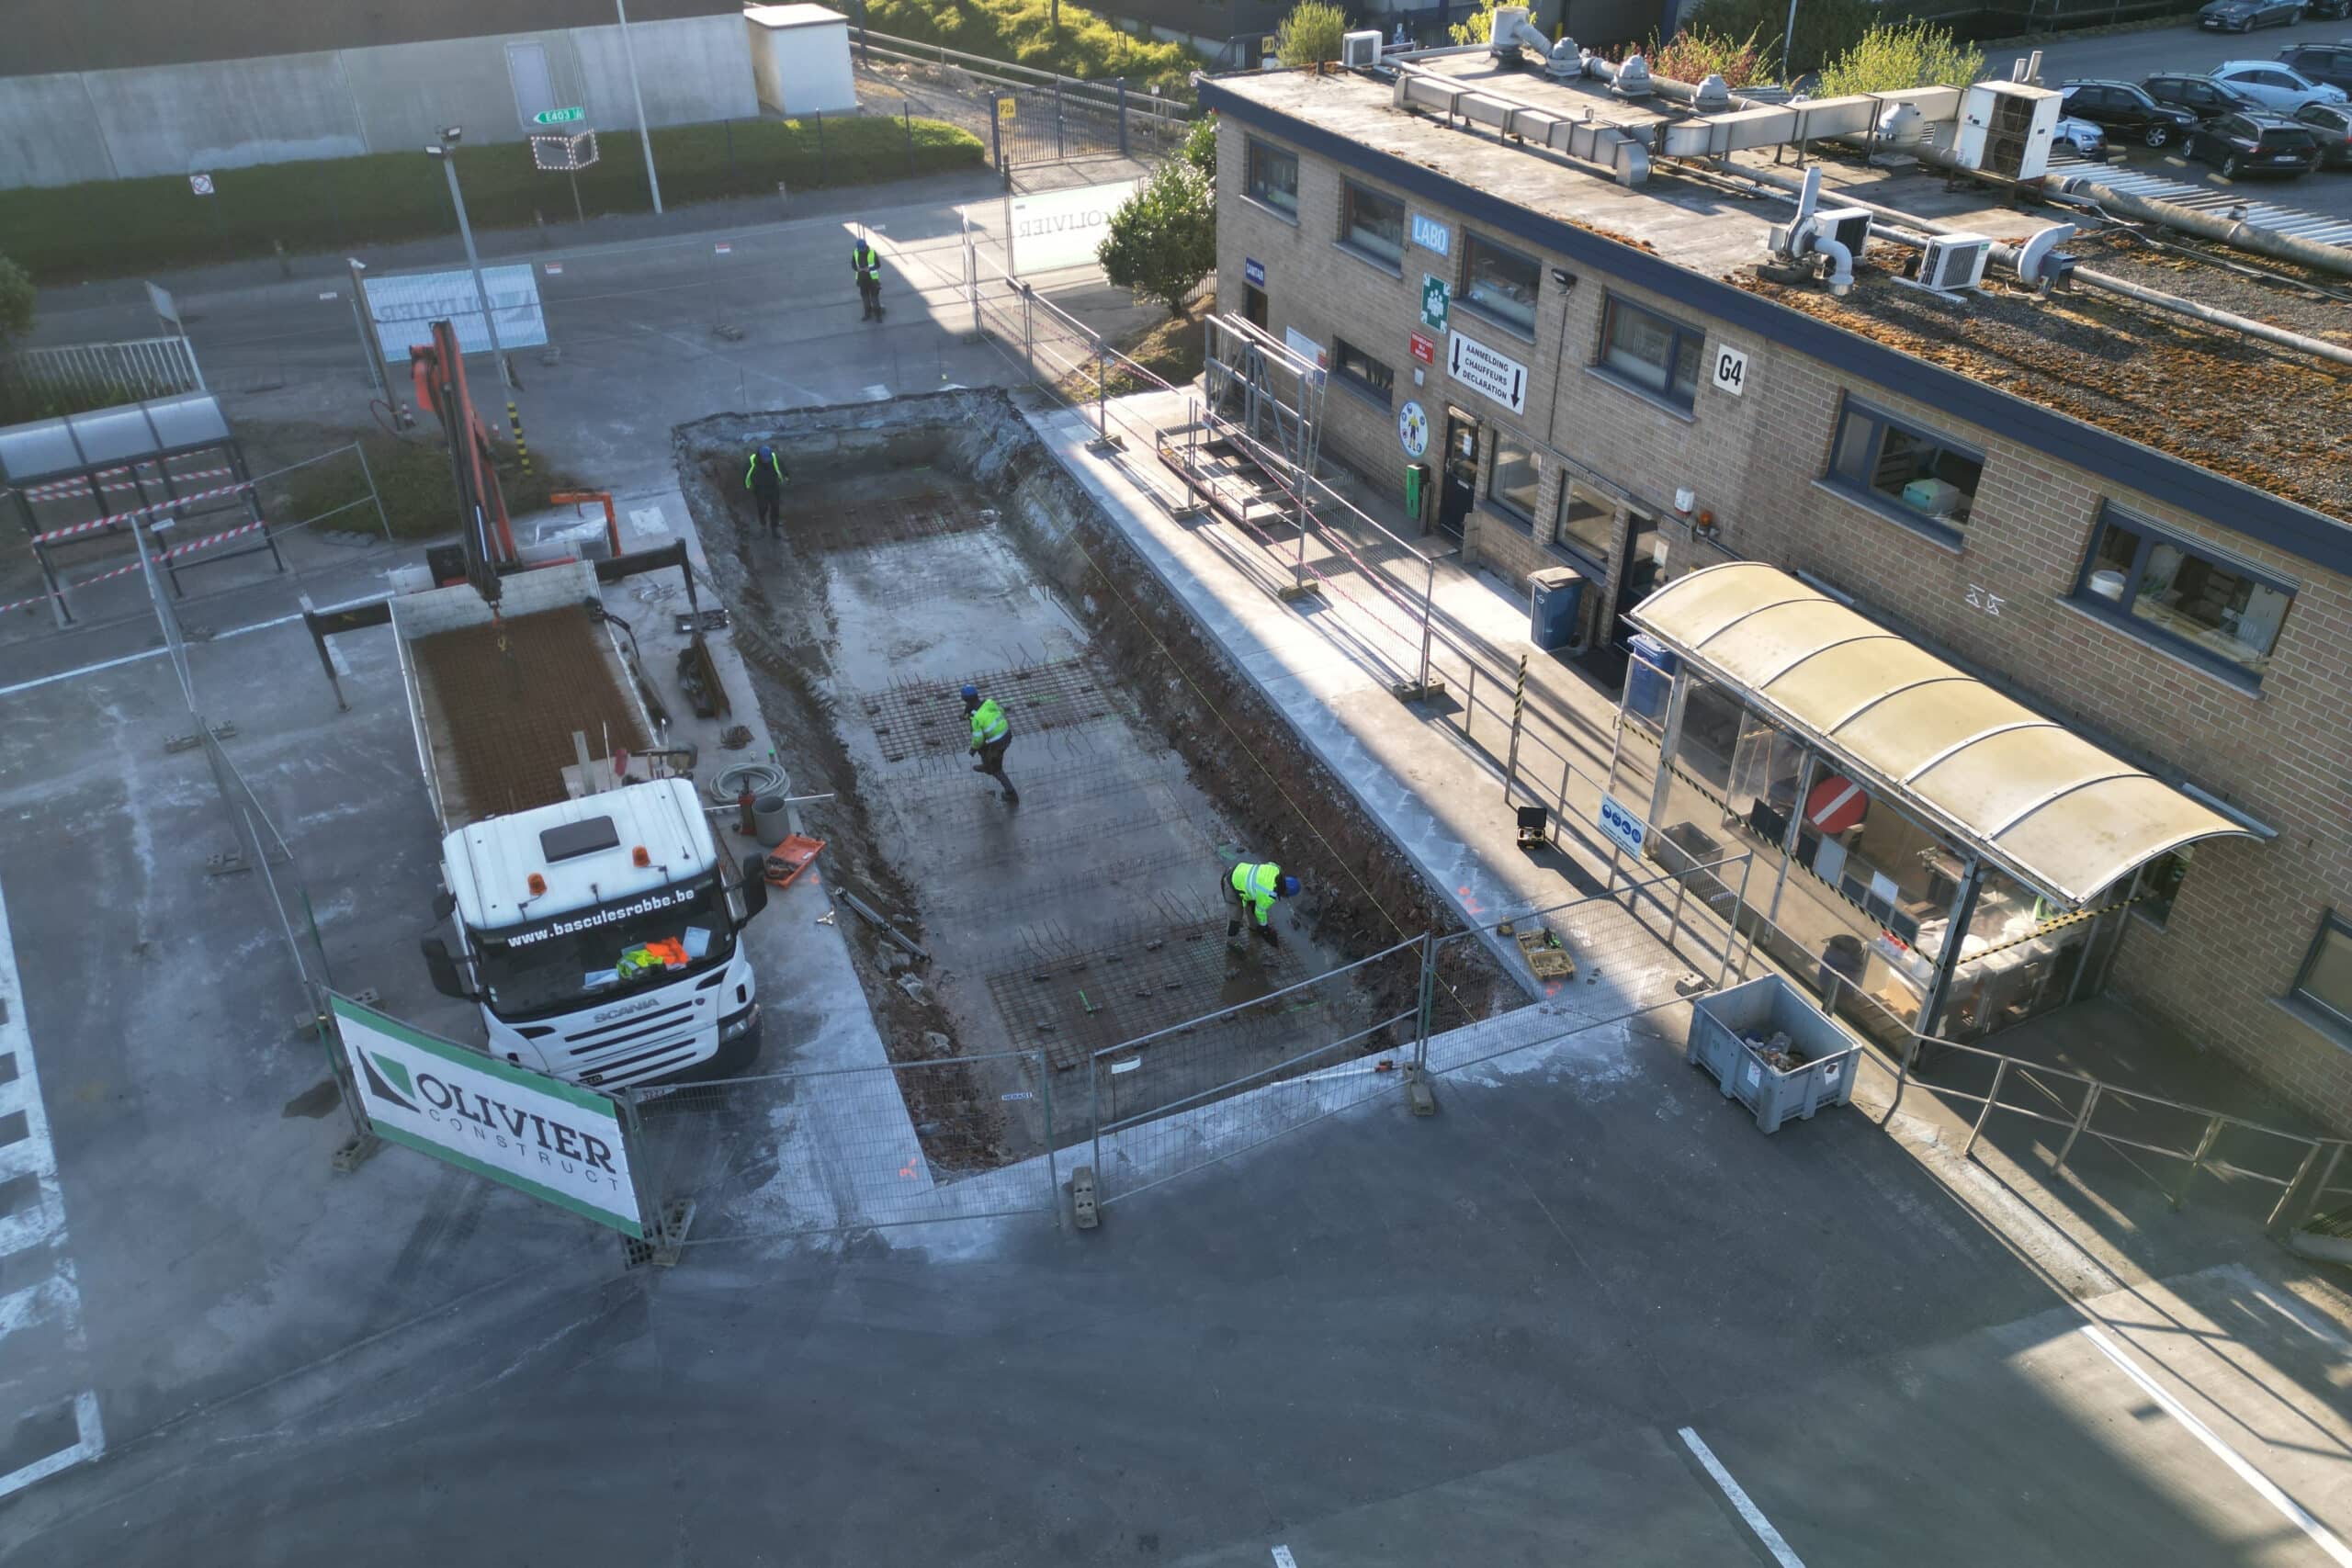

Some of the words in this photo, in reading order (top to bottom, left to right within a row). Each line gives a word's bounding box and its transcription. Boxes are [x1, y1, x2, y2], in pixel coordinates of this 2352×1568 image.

[545, 109, 571, 121] E403
[1415, 218, 1446, 250] LABO
[1464, 357, 1507, 386] CHAUFFEURS
[1466, 344, 1509, 372] AANMELDING
[1719, 355, 1742, 386] G4
[1463, 369, 1507, 400] DECLARATION
[508, 889, 695, 948] www.basculesrobbe.be
[594, 998, 660, 1023] SCANIA
[416, 1073, 616, 1174] OLIVIER
[429, 1109, 618, 1191] CONSTRUCT
